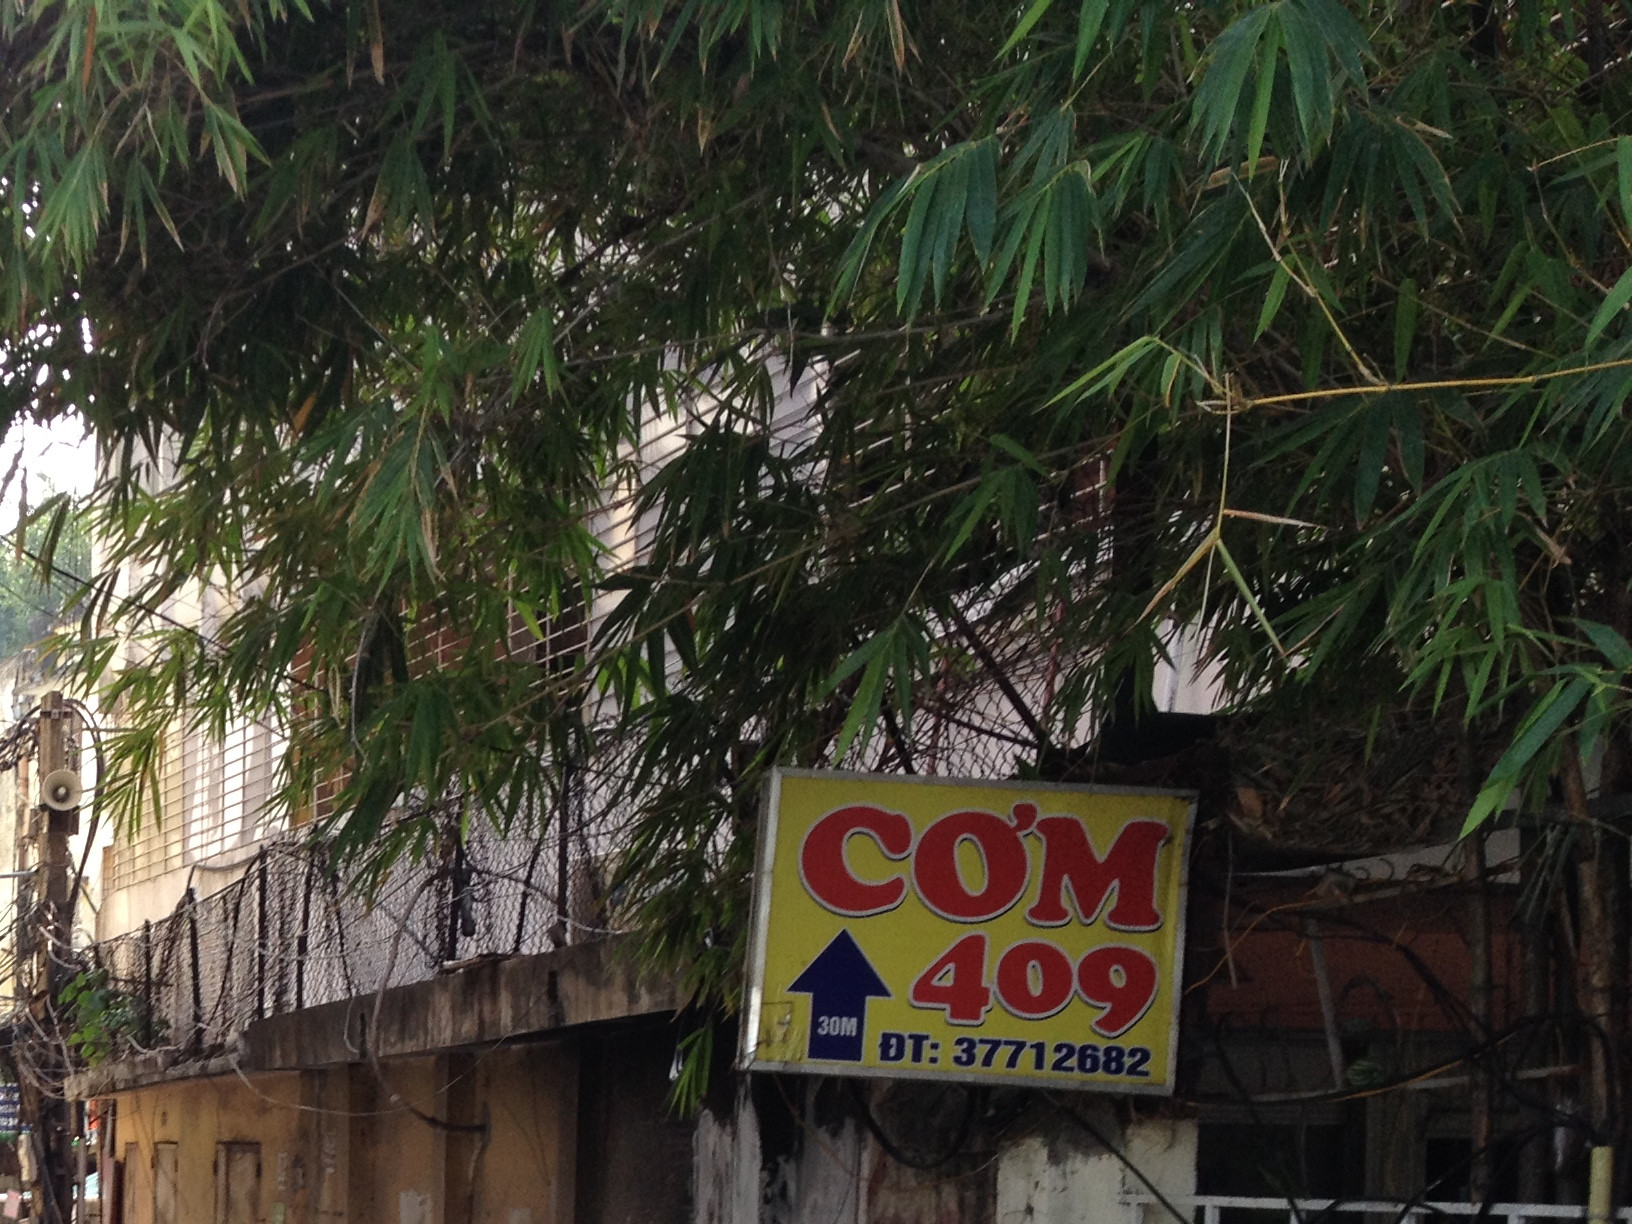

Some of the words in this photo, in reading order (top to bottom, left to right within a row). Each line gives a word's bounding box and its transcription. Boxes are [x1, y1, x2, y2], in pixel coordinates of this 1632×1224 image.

[909, 931, 1159, 1039] 409
[817, 1015, 857, 1037] 30M
[878, 1031, 940, 1064] ĐT:
[953, 1036, 1152, 1078] 37712682
